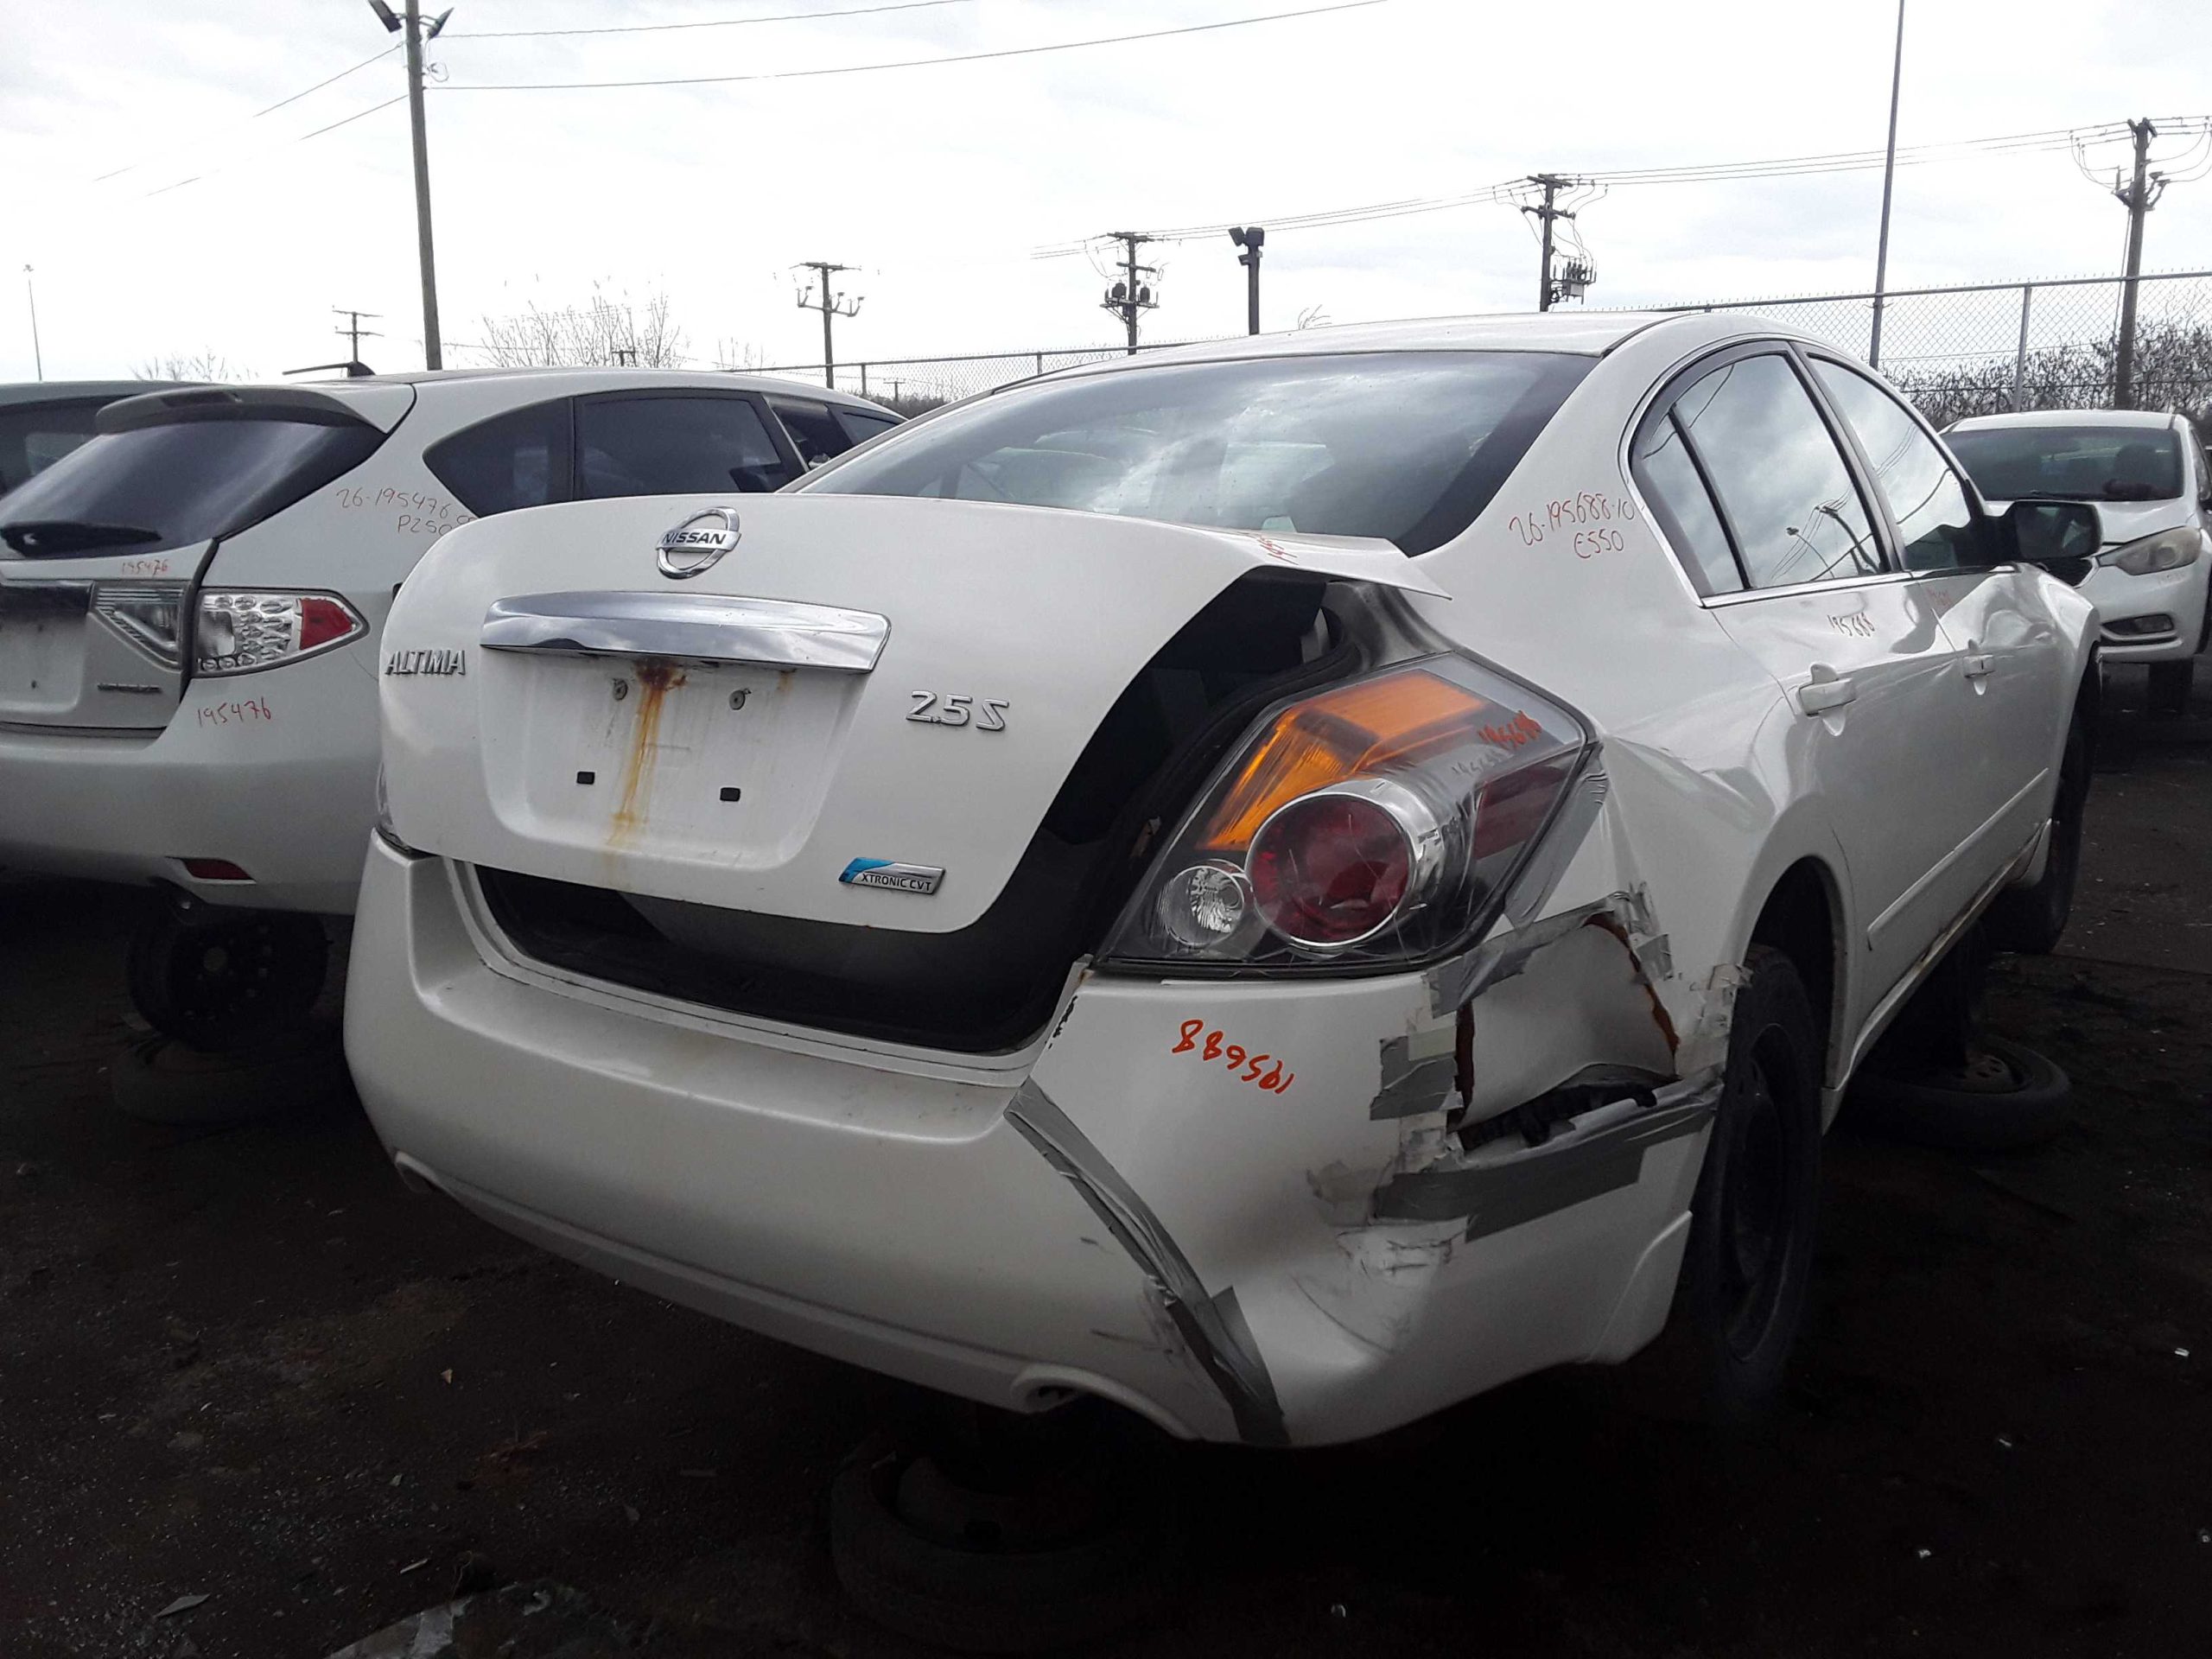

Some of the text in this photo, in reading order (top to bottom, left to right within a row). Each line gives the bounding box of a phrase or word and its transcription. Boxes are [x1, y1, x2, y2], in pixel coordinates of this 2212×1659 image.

[662, 531, 727, 545] NISSAN
[385, 649, 466, 676] ALTIMA
[197, 695, 271, 728] 195476
[861, 873, 931, 892] XTRONIC CVT
